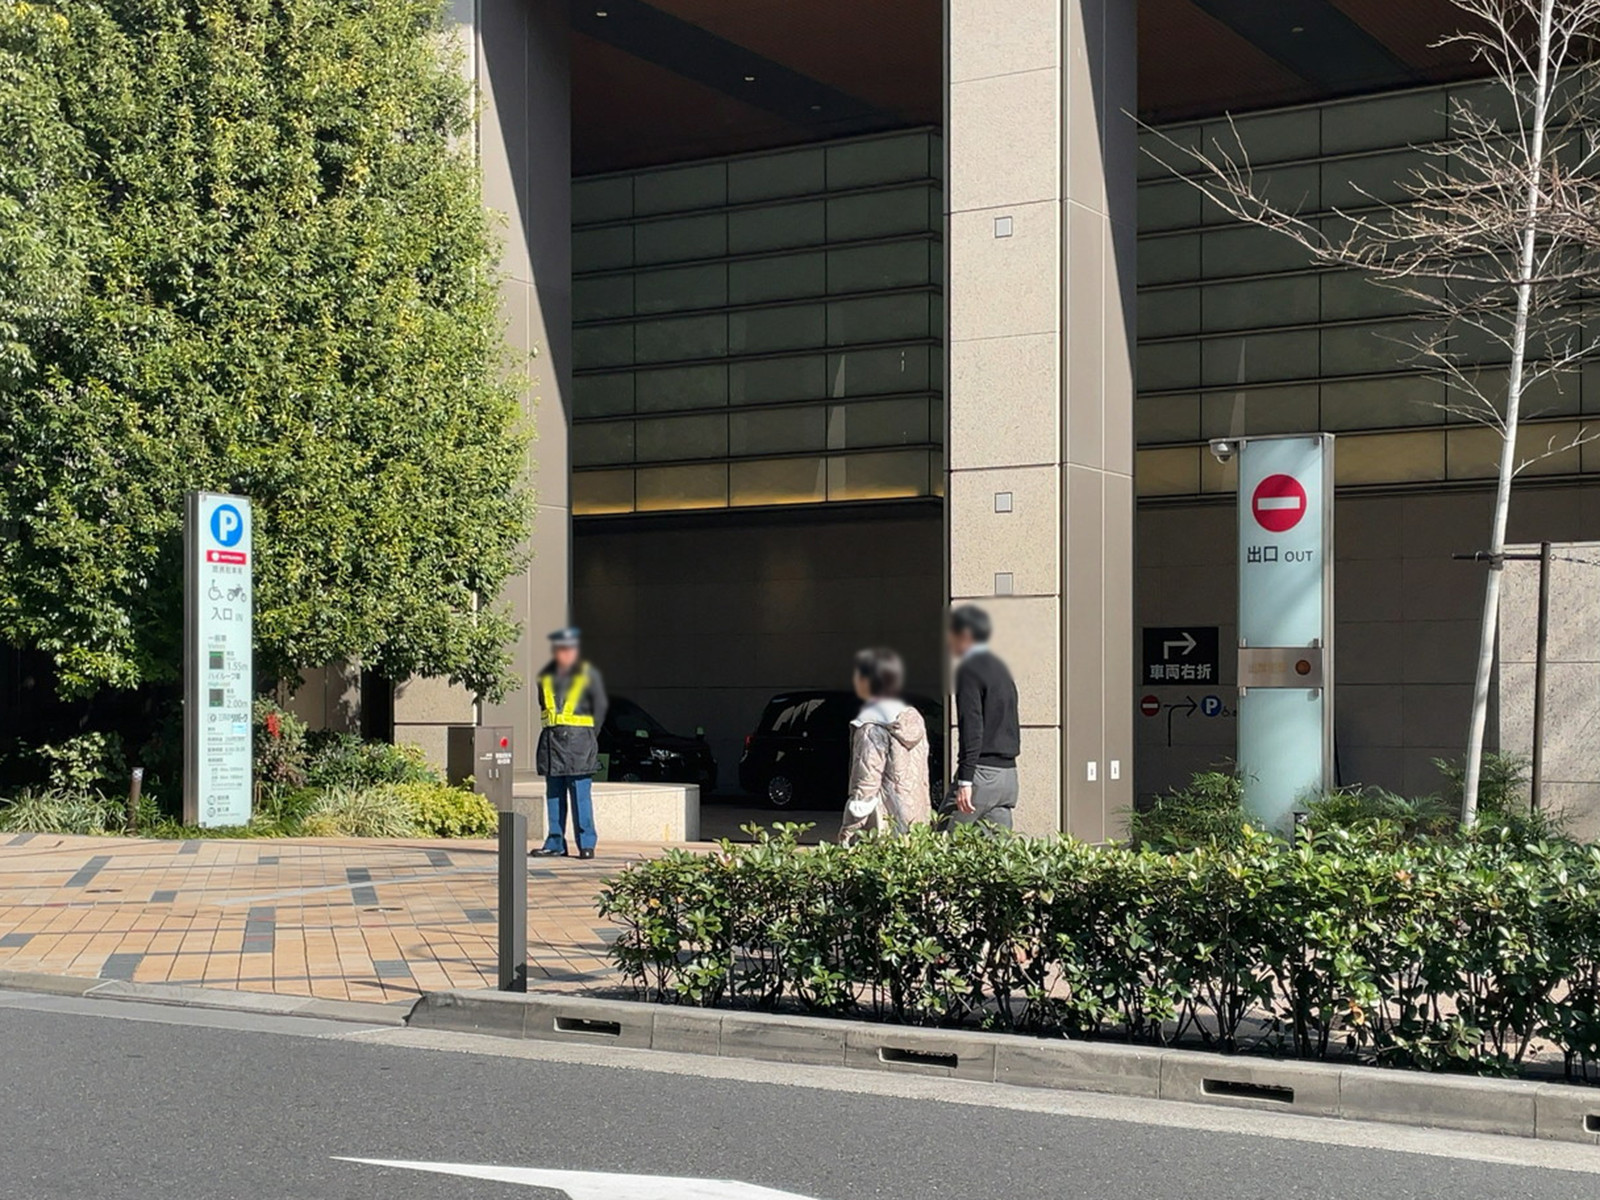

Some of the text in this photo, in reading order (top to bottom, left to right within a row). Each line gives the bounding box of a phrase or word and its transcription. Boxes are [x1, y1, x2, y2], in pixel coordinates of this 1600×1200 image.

[219, 510, 239, 541] P
[1247, 545, 1313, 563] 出口 OUT
[211, 607, 232, 621] 入口
[1149, 664, 1212, 680] 車両右折
[1205, 698, 1218, 714] P
